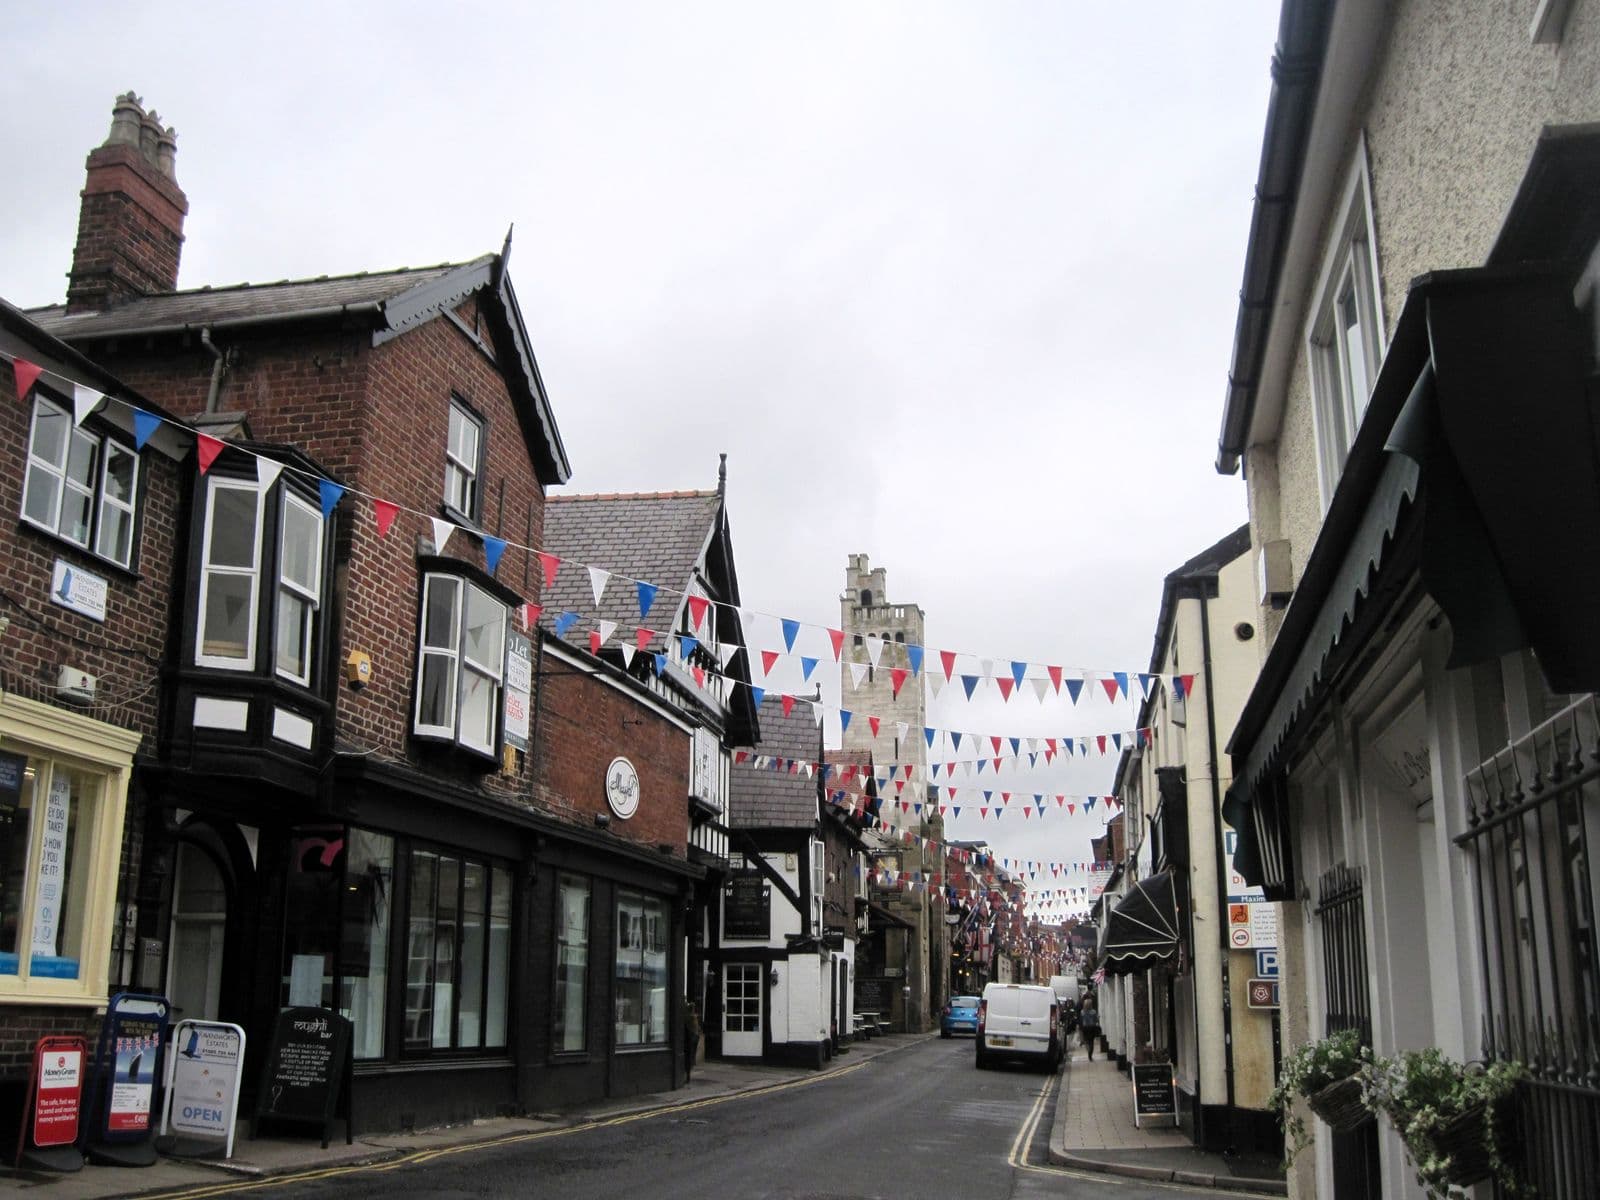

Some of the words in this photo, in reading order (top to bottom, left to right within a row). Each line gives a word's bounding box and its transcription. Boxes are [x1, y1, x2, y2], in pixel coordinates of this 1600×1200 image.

[514, 637, 527, 658] Let
[1241, 895, 1266, 903] Maxim
[44, 1067, 76, 1077] MoneyGram
[38, 1116, 54, 1124] money
[54, 1114, 76, 1122] worldwide
[183, 1106, 222, 1122] OPEN
